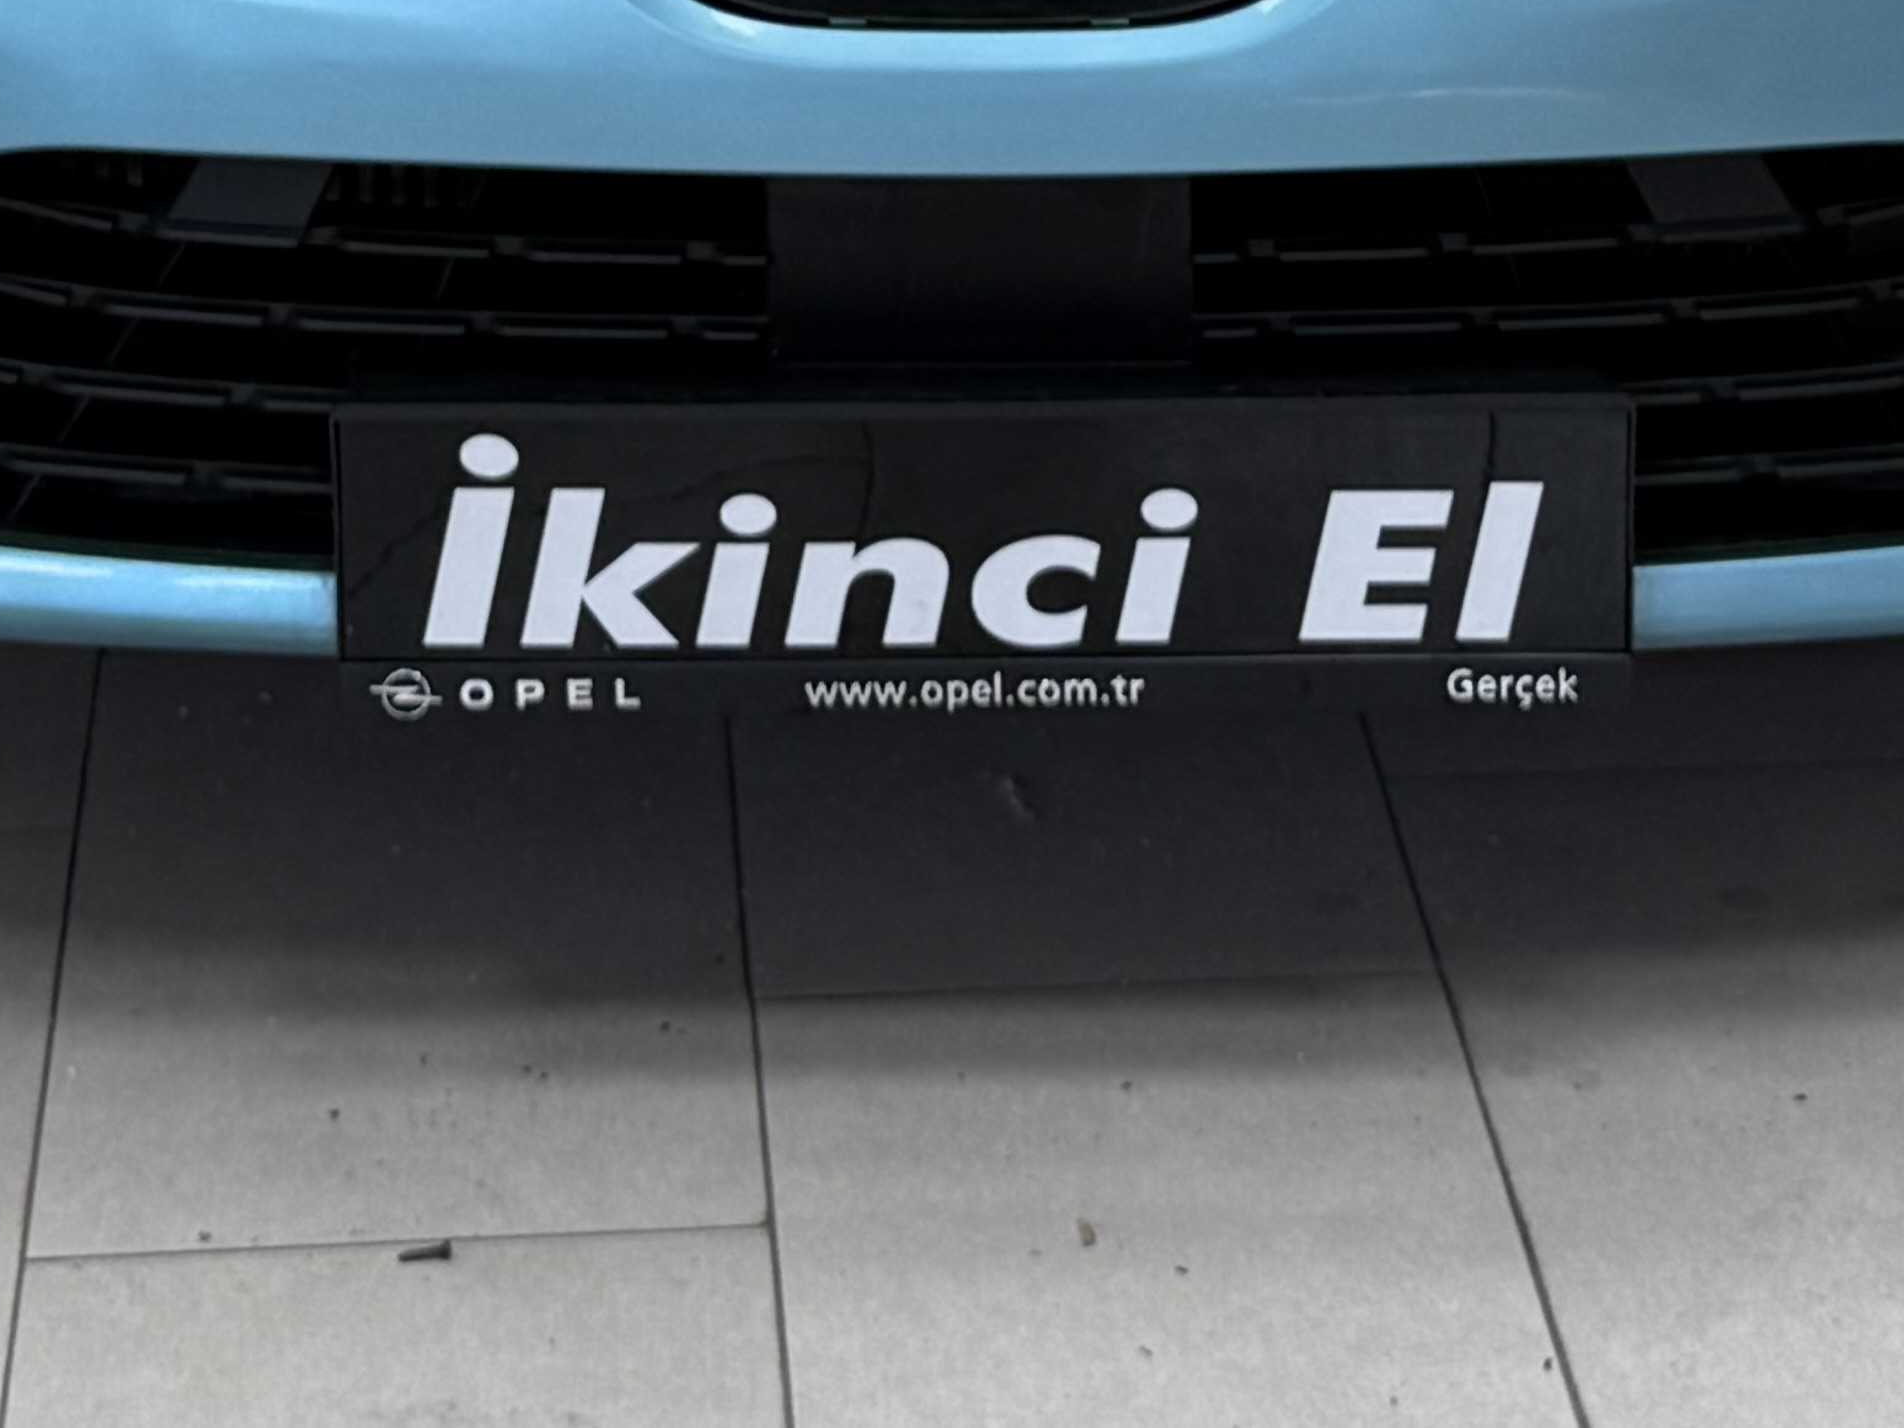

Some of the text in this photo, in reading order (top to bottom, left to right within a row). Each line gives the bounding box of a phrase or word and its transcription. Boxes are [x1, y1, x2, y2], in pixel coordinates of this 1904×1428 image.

[422, 433, 1544, 648] İkinci El
[459, 677, 642, 711] OPEL
[803, 670, 1146, 713] www.opel.com.tr
[1446, 666, 1579, 711] Gerçek
